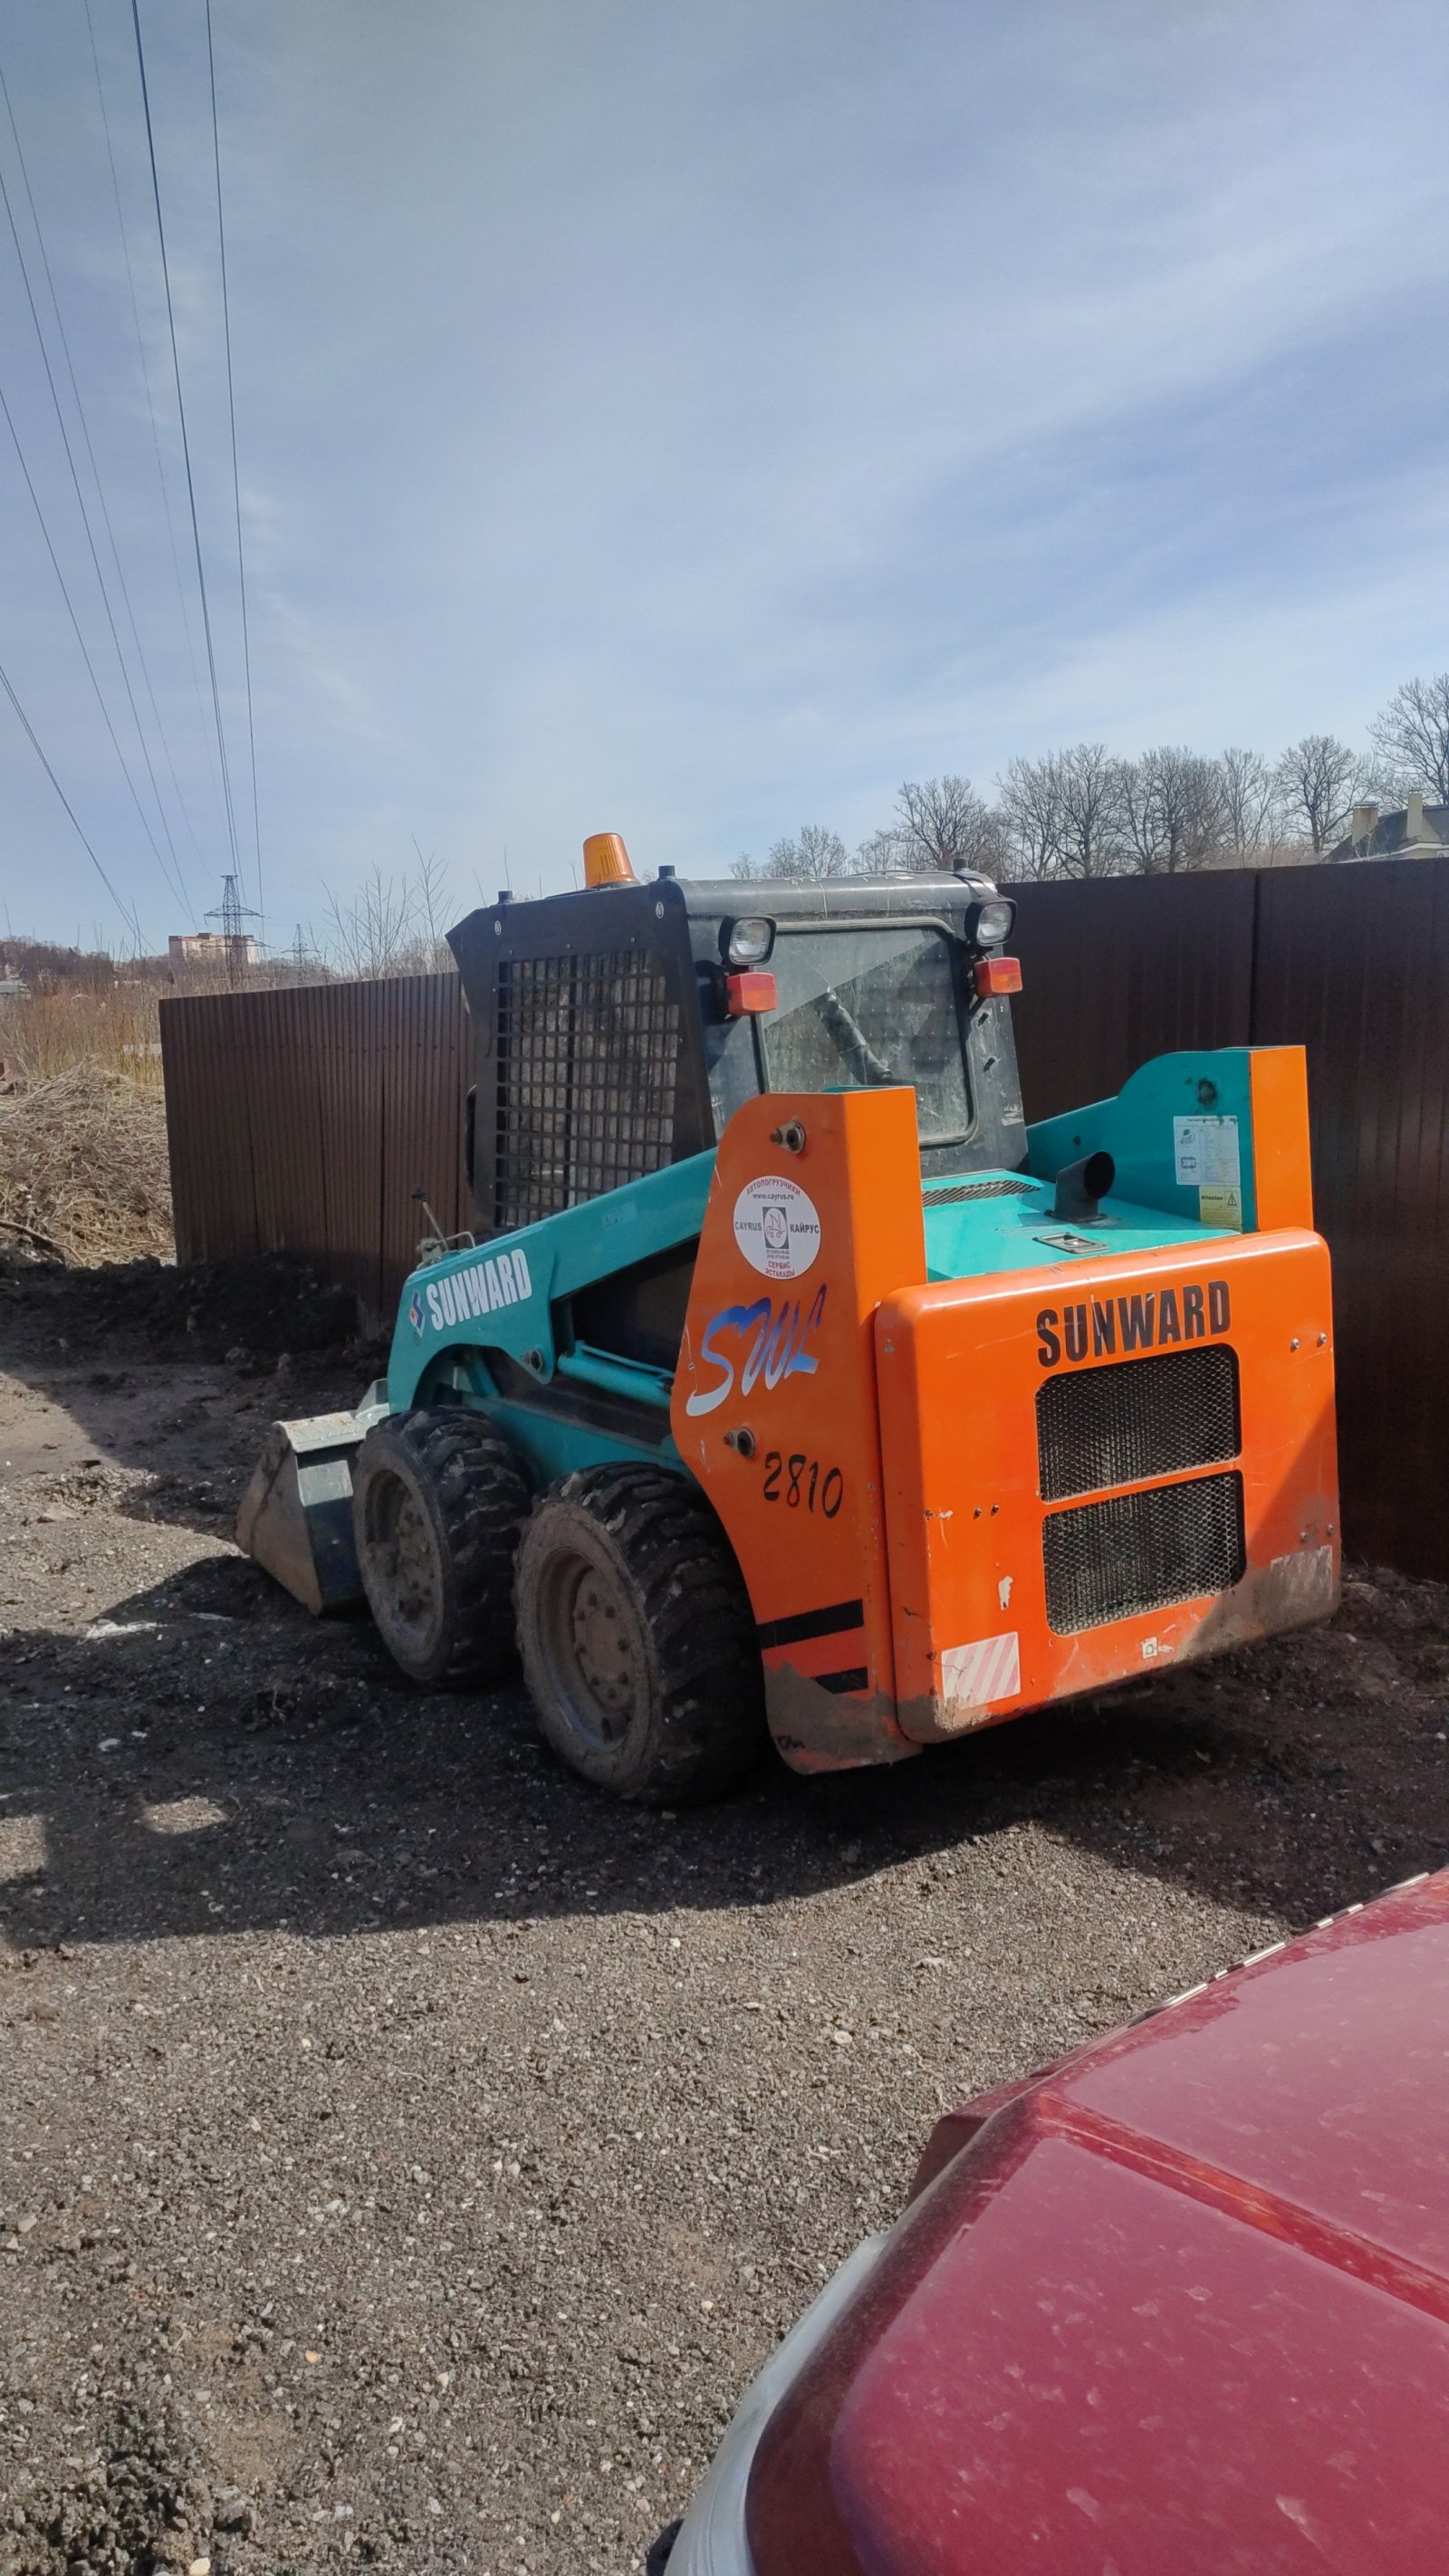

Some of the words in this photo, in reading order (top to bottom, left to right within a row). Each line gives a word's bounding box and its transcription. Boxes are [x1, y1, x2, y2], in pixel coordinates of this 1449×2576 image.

[746, 1178, 801, 1197] АВТОПОГРУЗЧИКИ
[753, 1193, 794, 1201] www.cayrus.ru
[735, 1222, 762, 1231] CAYRUS
[790, 1222, 819, 1234] КАЙРУС
[768, 1260, 791, 1269] СЕРВИС
[764, 1268, 795, 1278] ЭСТАКАДЫ
[427, 1248, 533, 1331] SUNWARD
[1036, 1280, 1231, 1368] SUNWARD
[763, 1451, 844, 1519] 2810
